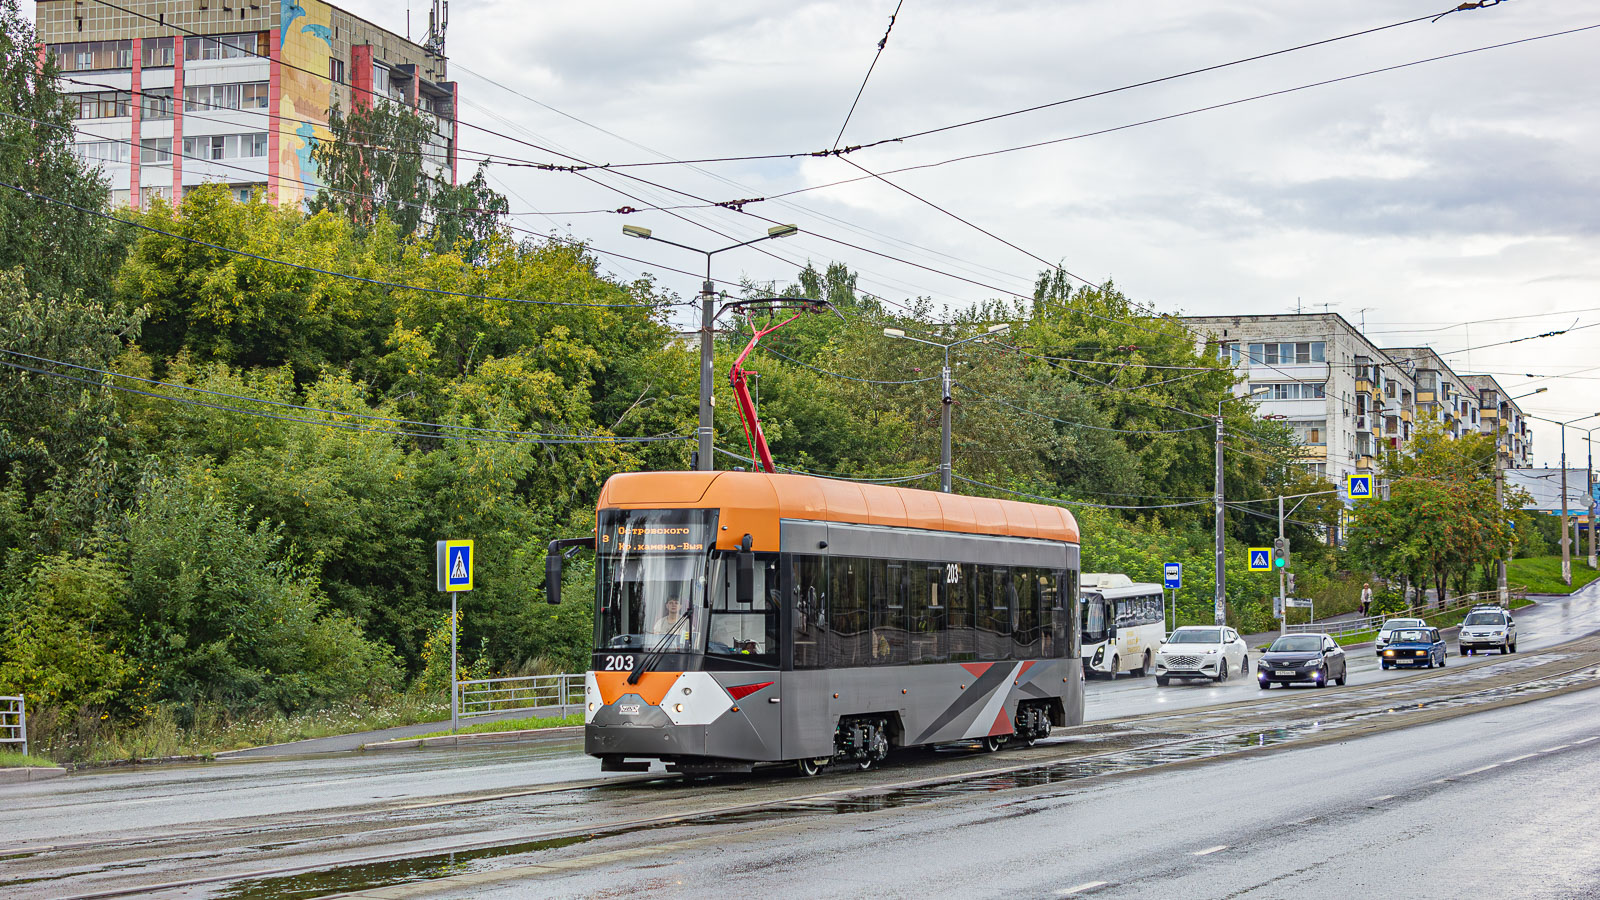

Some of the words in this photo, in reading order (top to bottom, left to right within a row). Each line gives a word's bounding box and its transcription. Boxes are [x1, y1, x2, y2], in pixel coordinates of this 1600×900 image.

[618, 527, 689, 535] Островского
[603, 534, 609, 542] 3
[947, 563, 958, 583] 203
[605, 655, 633, 670] 203
